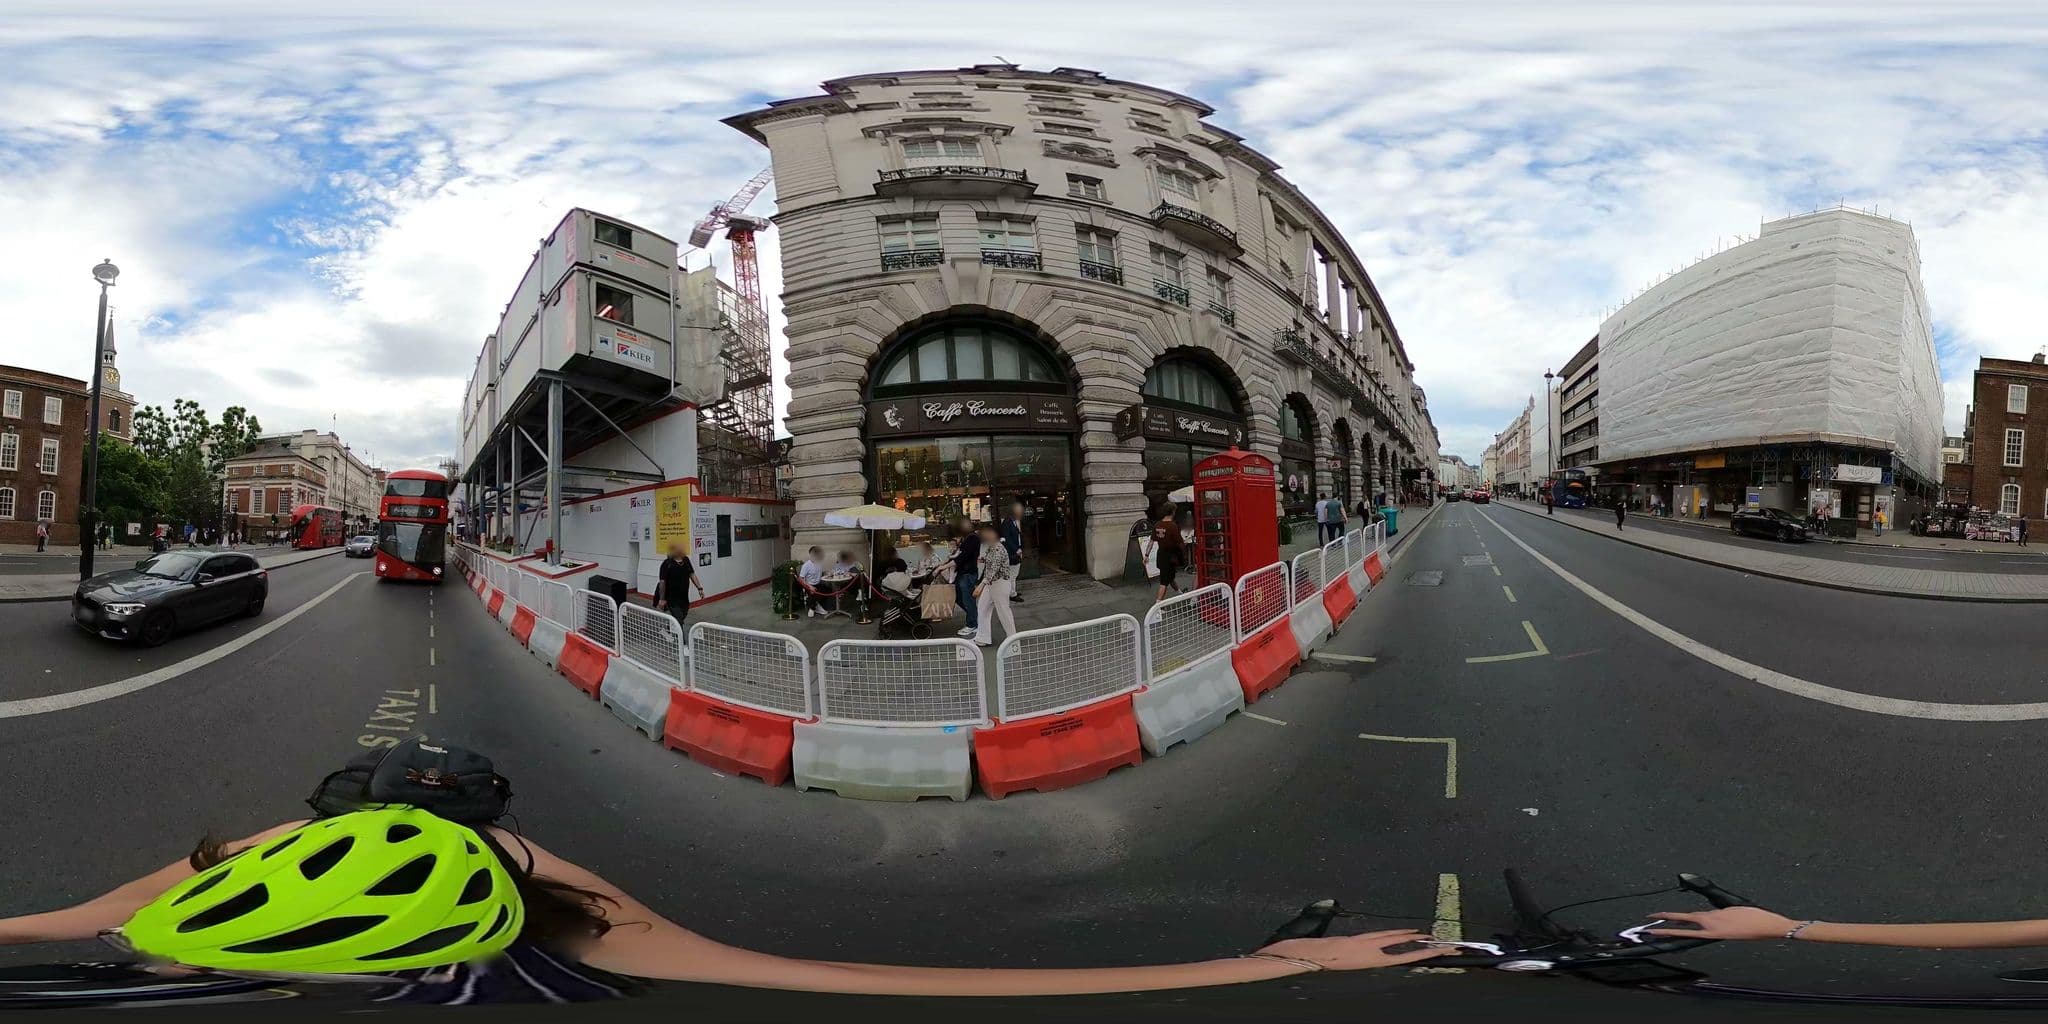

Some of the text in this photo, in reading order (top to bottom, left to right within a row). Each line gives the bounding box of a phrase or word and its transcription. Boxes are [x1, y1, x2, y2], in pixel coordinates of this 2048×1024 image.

[630, 349, 651, 363] KIER
[966, 401, 1028, 416] Concerto
[637, 499, 651, 507] KIER
[357, 688, 421, 749] TAXIS
